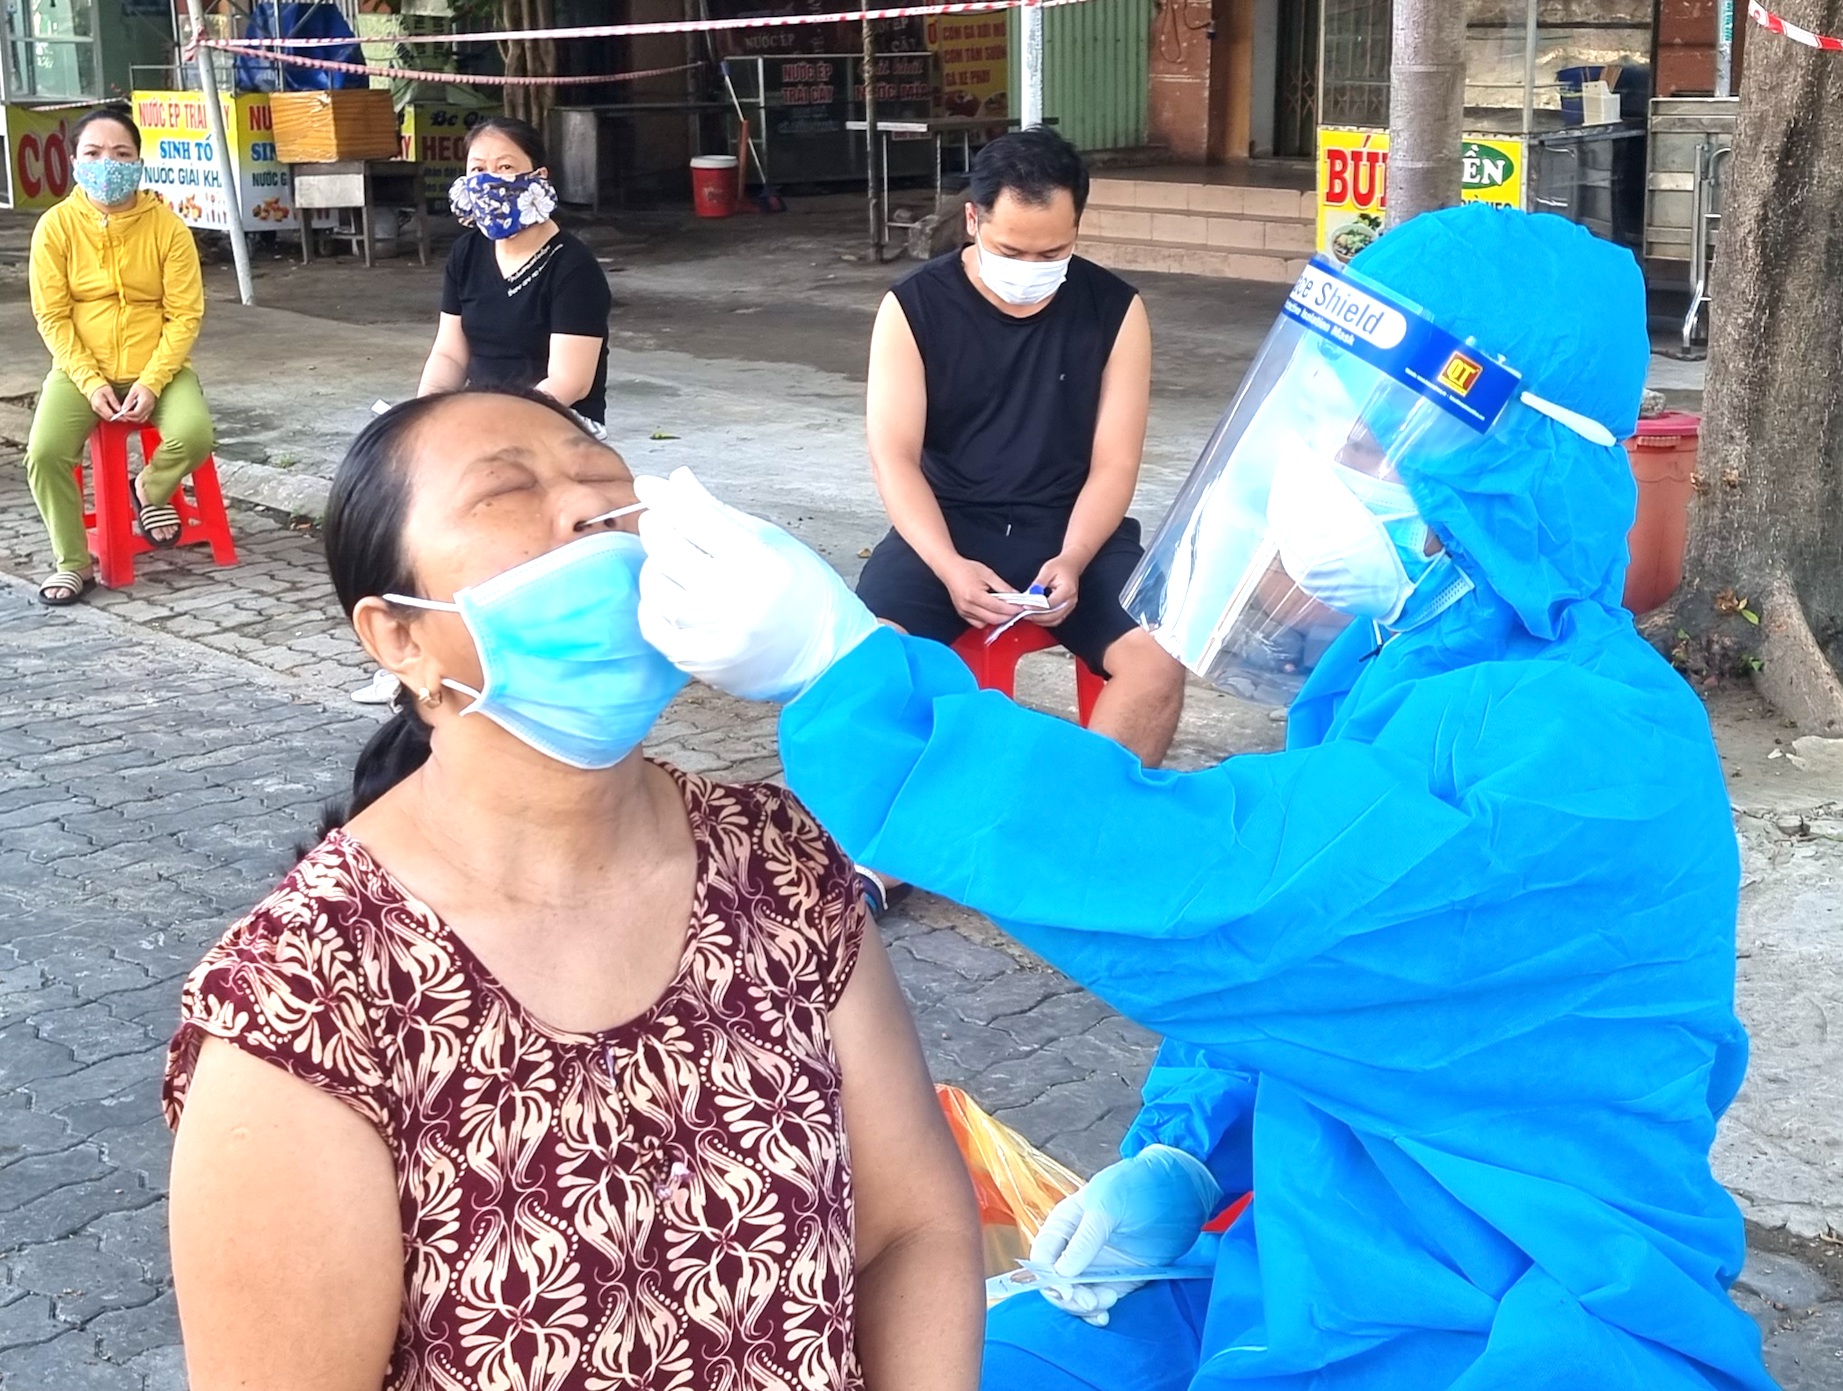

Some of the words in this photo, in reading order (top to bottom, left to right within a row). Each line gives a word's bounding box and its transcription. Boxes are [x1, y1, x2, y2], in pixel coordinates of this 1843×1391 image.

[17, 118, 69, 198] CƠ
[159, 140, 191, 160] SINH
[195, 133, 213, 161] TỐ
[1461, 144, 1506, 187] ỀN
[1299, 307, 1331, 332] Isolation
[1329, 324, 1355, 346] Mask
[1314, 281, 1385, 335] Shield
